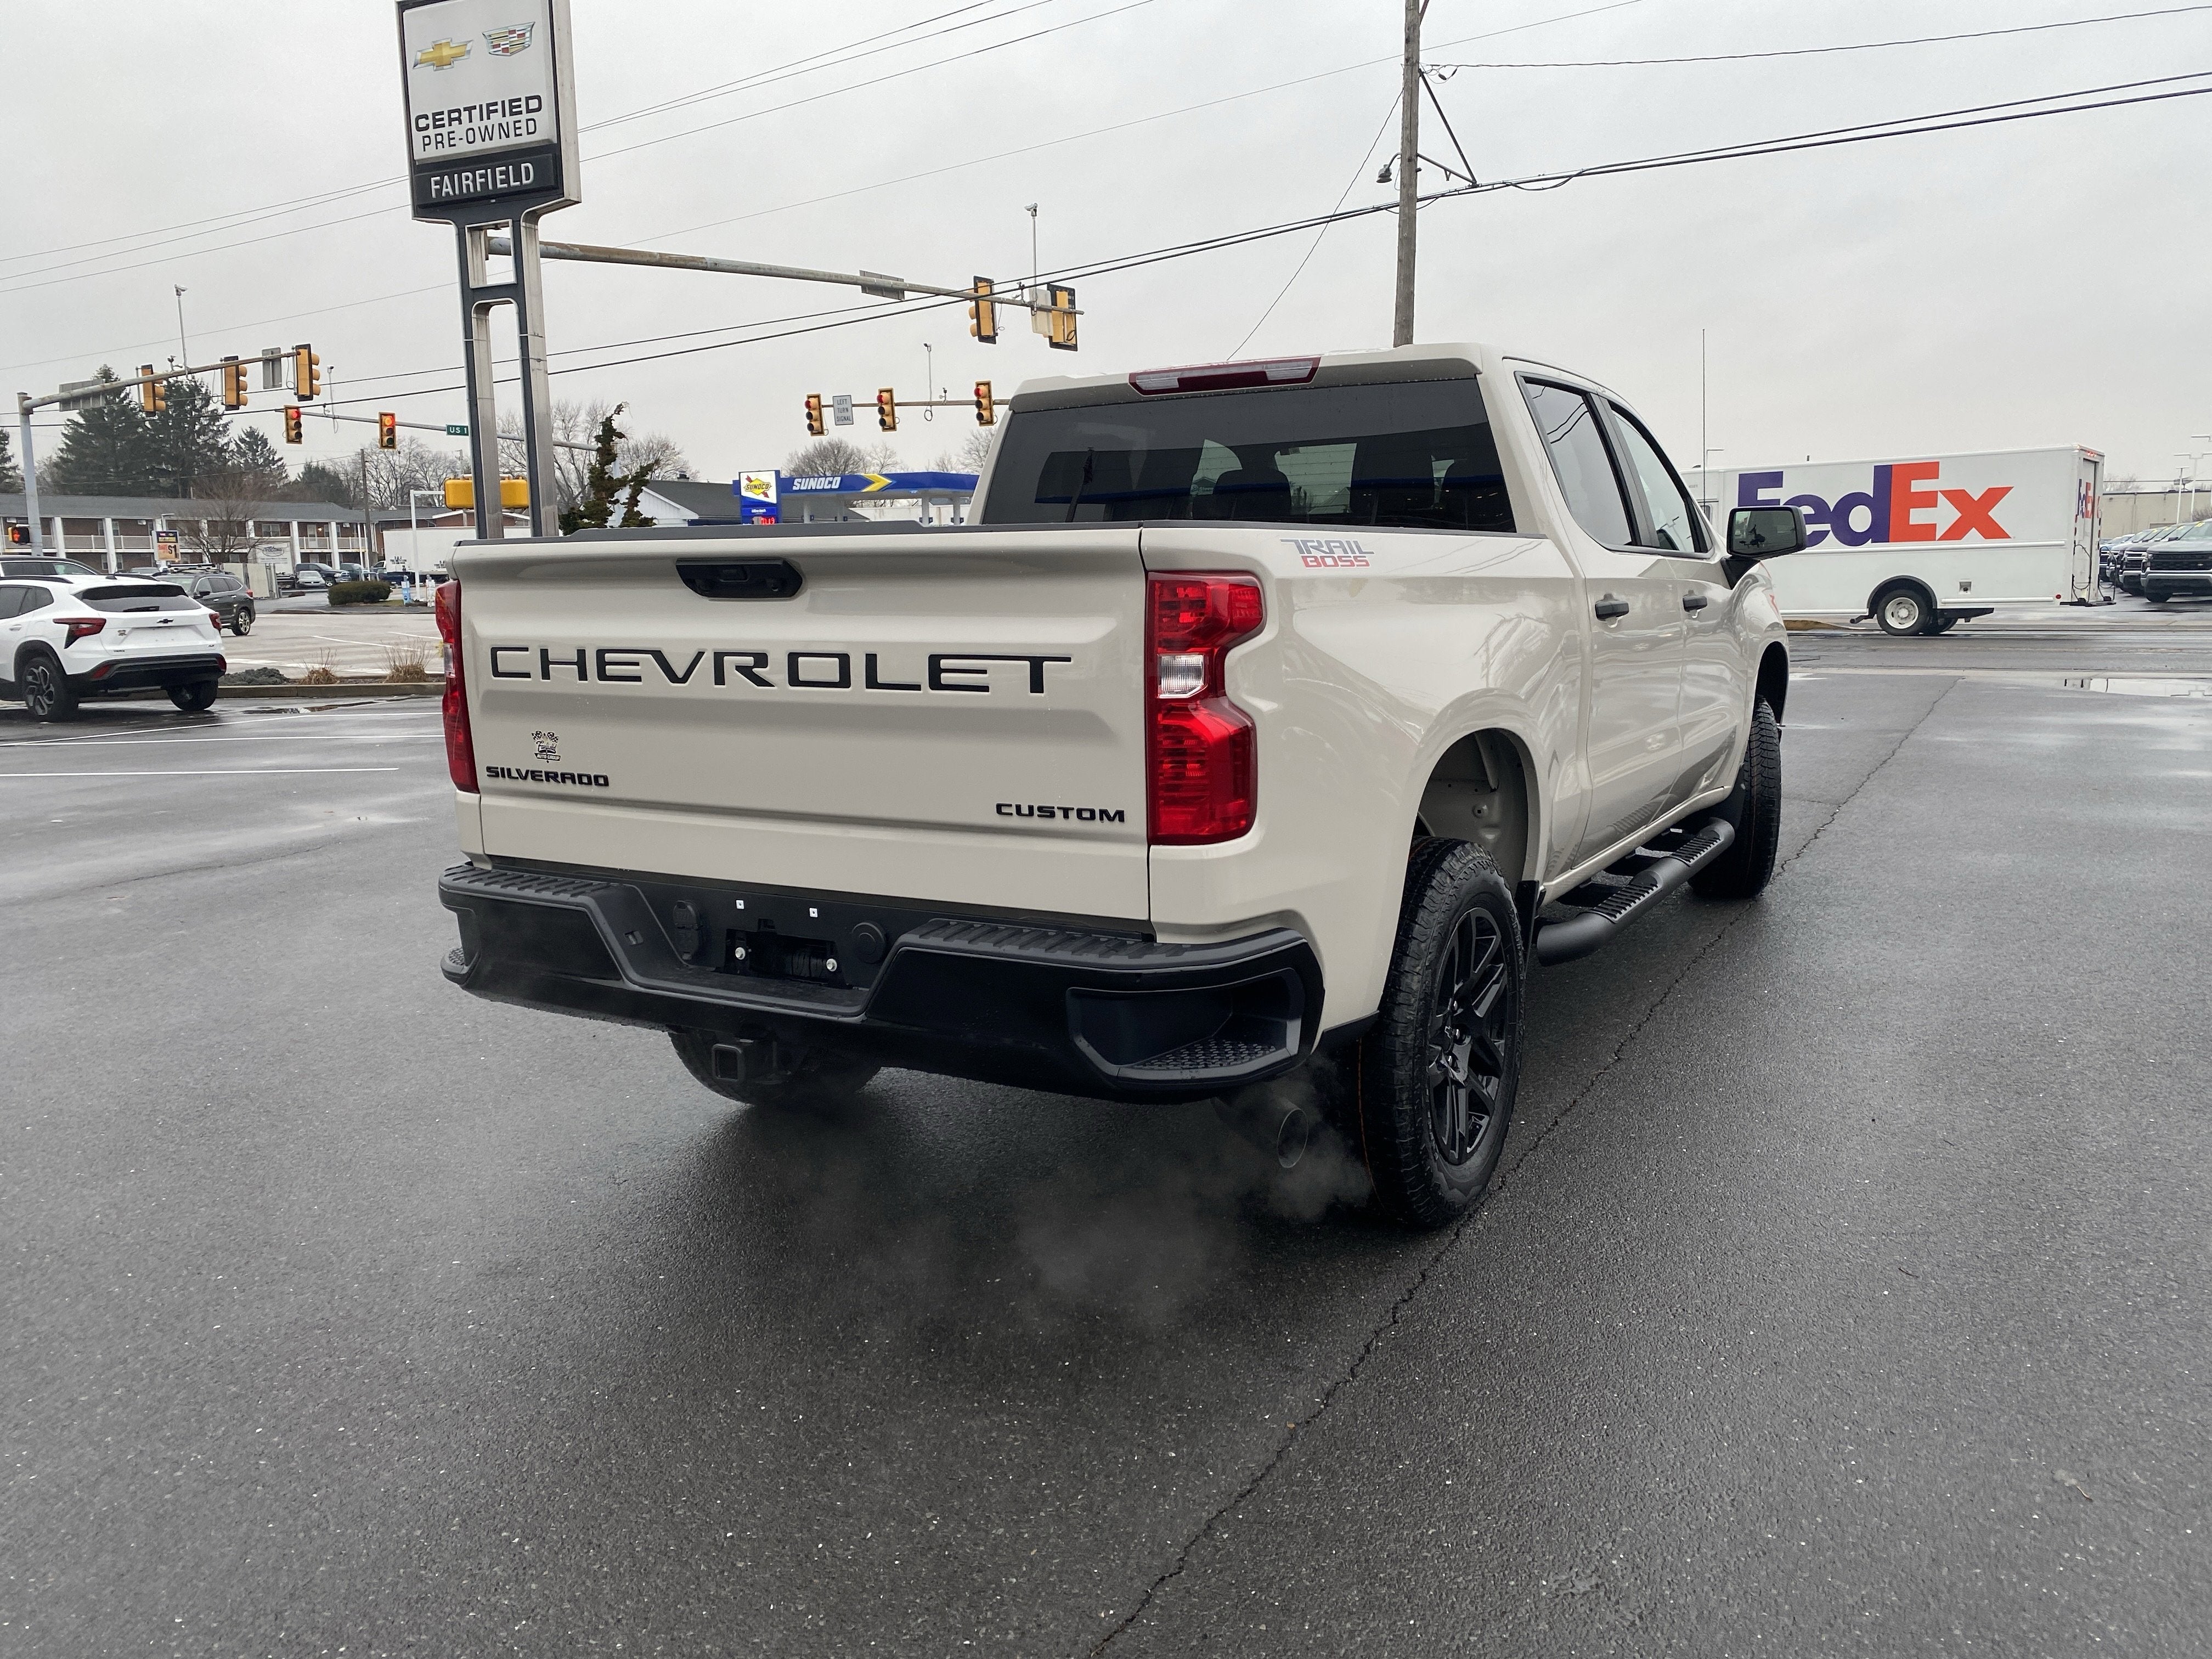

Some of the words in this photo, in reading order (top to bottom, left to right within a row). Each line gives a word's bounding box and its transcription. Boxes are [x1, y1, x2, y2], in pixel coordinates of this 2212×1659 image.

[414, 94, 543, 132] CERTIFIED
[422, 117, 537, 152] PRE-OWNED
[430, 162, 534, 199] FAIRFIELD
[793, 477, 841, 490] SUNOCO
[1737, 461, 2015, 547] FedEx
[1280, 539, 1375, 555] TRAIL
[1301, 555, 1370, 568] BOSS
[490, 646, 1071, 694] CHEVROLET
[486, 765, 609, 787] SILVERADO
[996, 803, 1125, 822] CUSTOM
